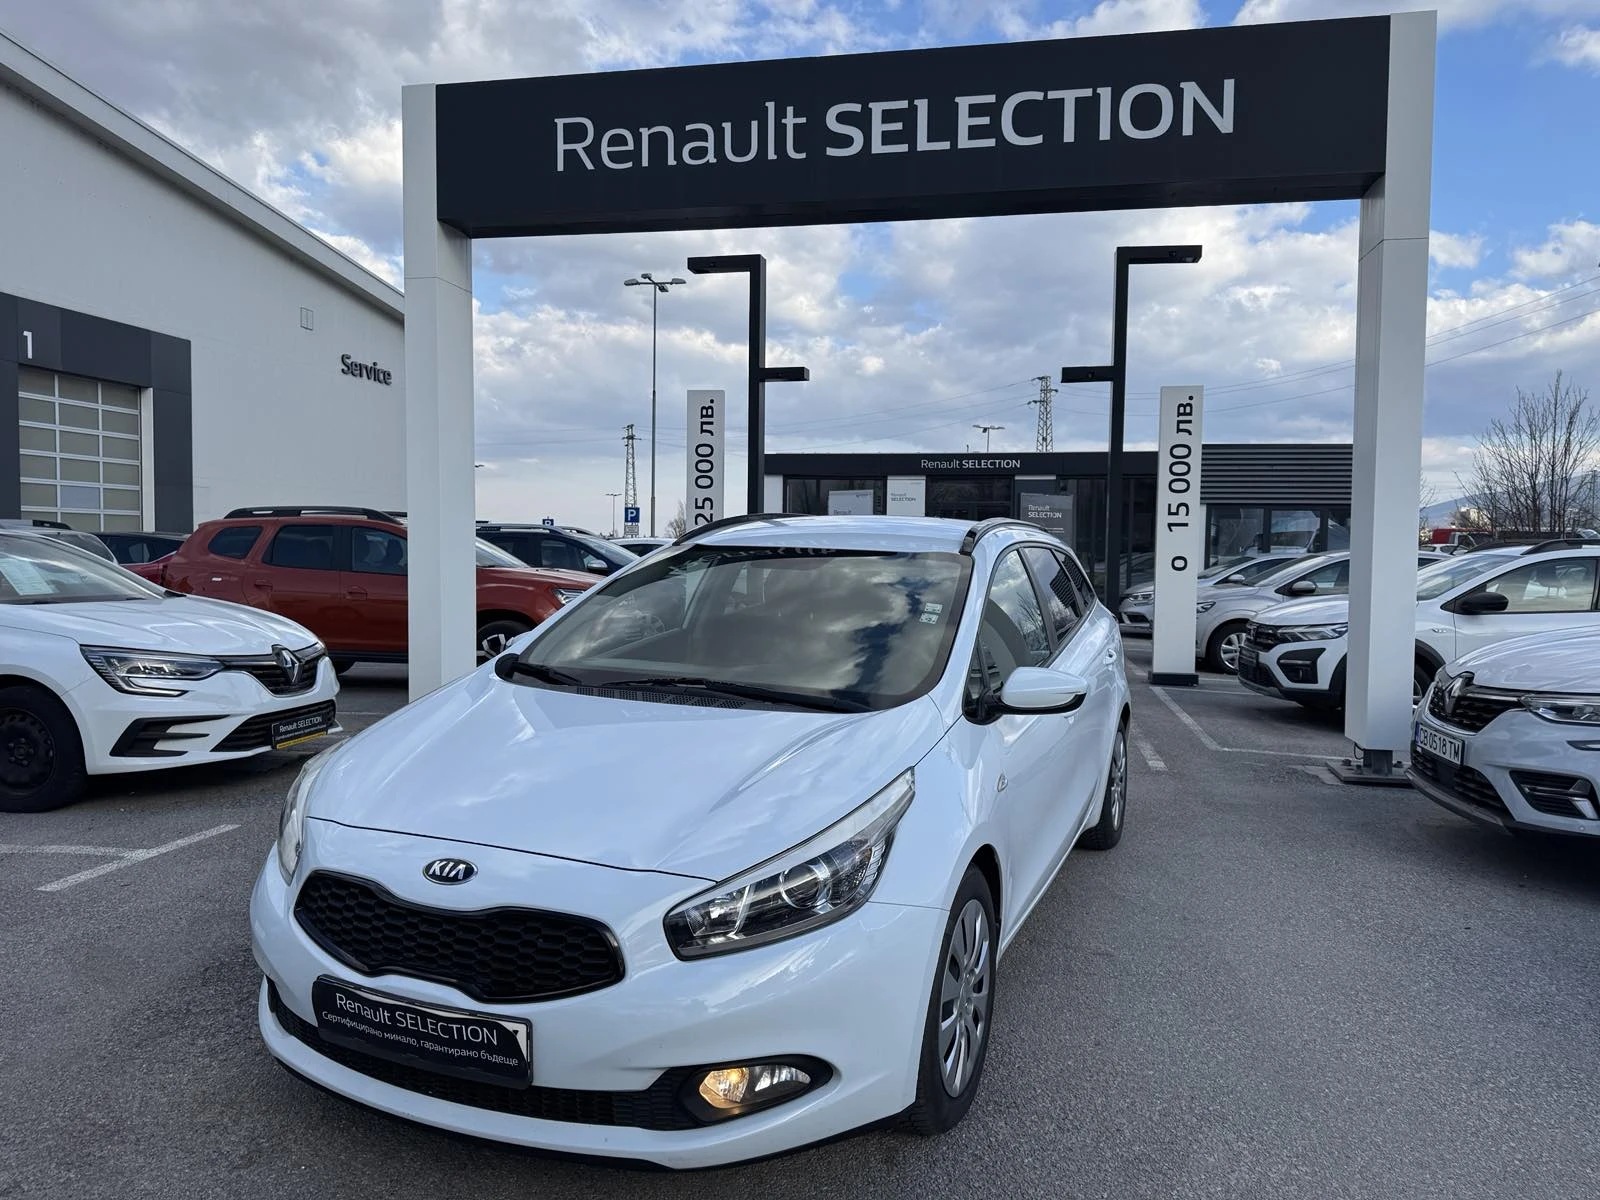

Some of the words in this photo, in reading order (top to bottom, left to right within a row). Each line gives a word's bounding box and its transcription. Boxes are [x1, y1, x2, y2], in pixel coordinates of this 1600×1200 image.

[554, 101, 807, 172] Renault
[825, 78, 1236, 157] SELECTION
[23, 330, 33, 359] 1
[341, 353, 392, 386] Service
[700, 398, 715, 436] лв.
[1176, 395, 1194, 436] лв.
[694, 443, 715, 490] 000
[921, 459, 960, 469] Renault
[962, 459, 1020, 469] SELECTION
[1168, 443, 1192, 494] 000
[627, 508, 637, 521] P
[694, 497, 714, 526] 25
[1167, 502, 1190, 533] 15
[297, 716, 322, 728] SELECTION
[428, 860, 466, 880] KIA
[335, 992, 392, 1026] Renault
[394, 1011, 499, 1046] SELECTION
[322, 1011, 382, 1038] Сертифицирано
[383, 1033, 420, 1048] минало,
[420, 1039, 479, 1059] гарантирано
[480, 1051, 520, 1067] бъдеще
